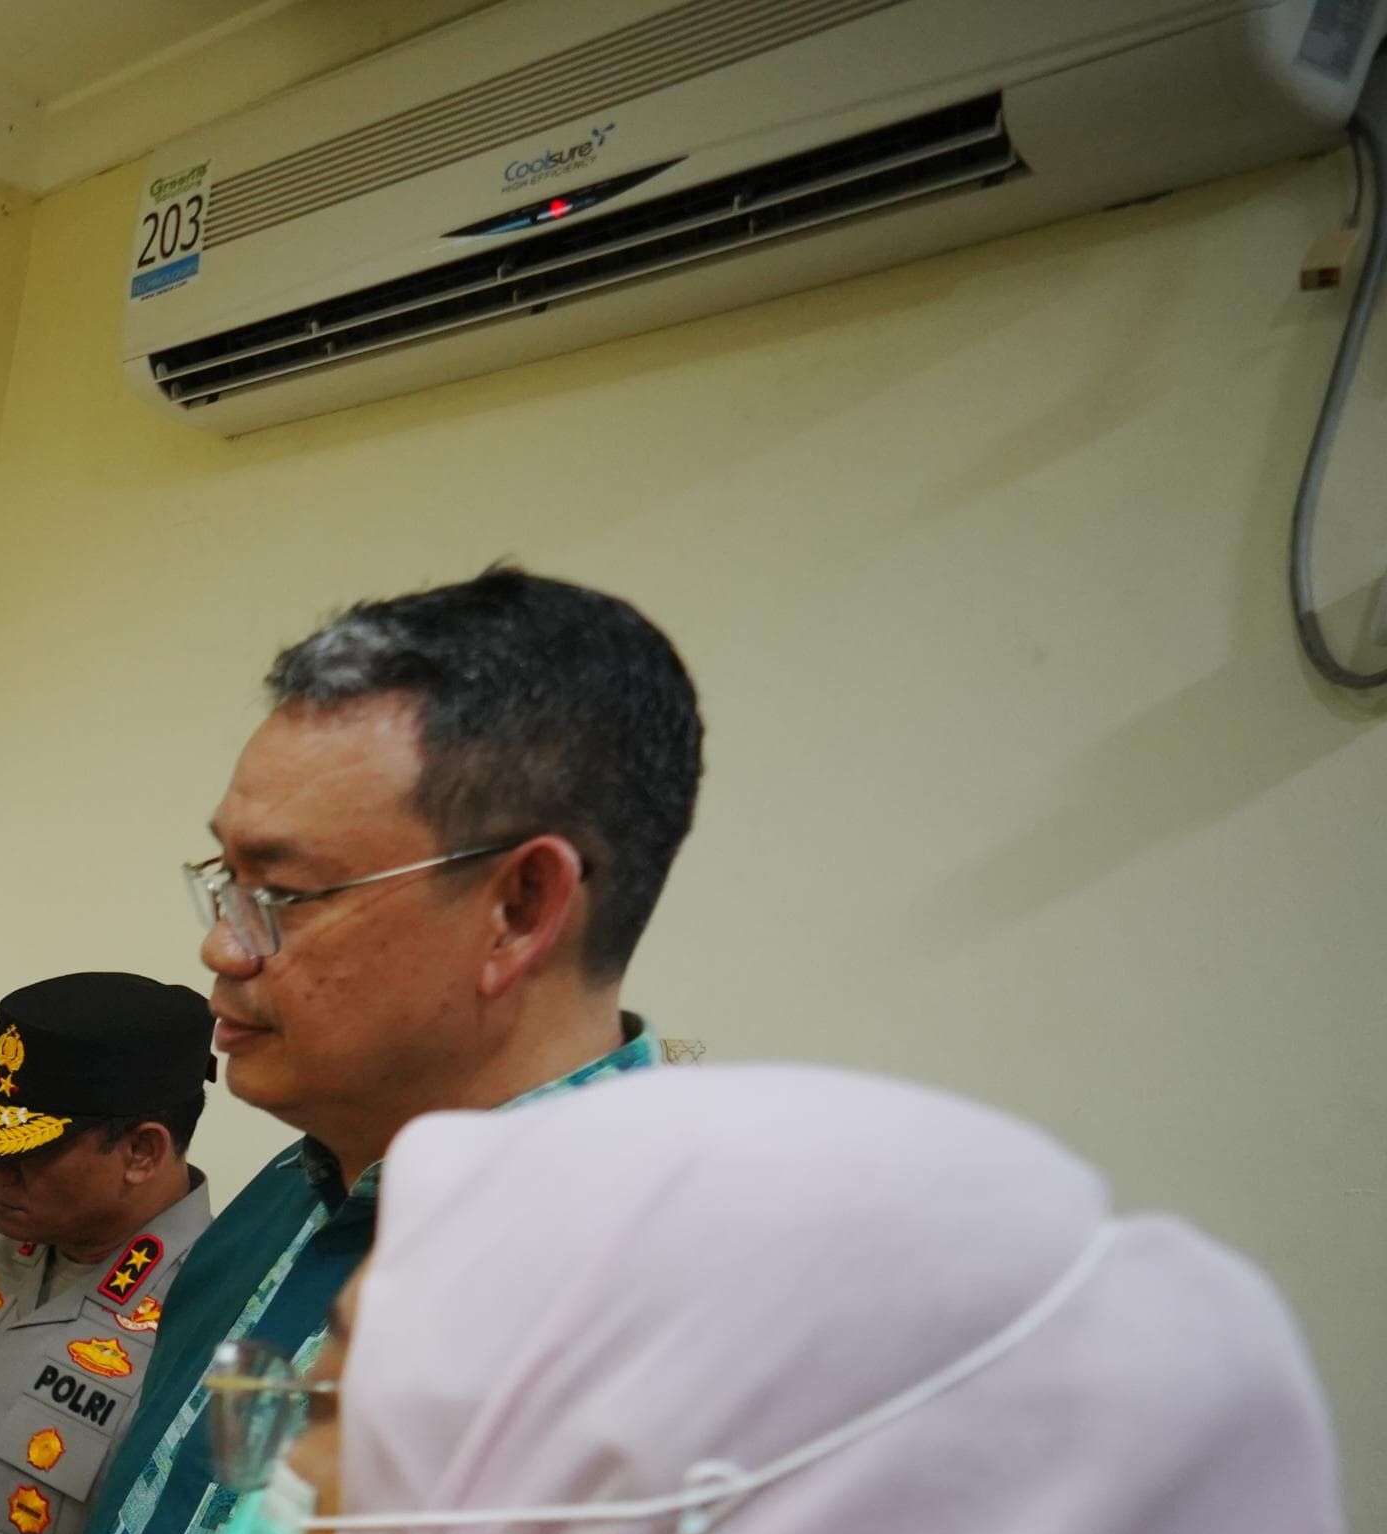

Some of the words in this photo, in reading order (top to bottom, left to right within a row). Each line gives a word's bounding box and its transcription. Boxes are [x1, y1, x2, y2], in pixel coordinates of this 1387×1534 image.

[504, 141, 593, 182] Coolsure
[137, 194, 203, 268] 203
[34, 1364, 116, 1426] POLRI
